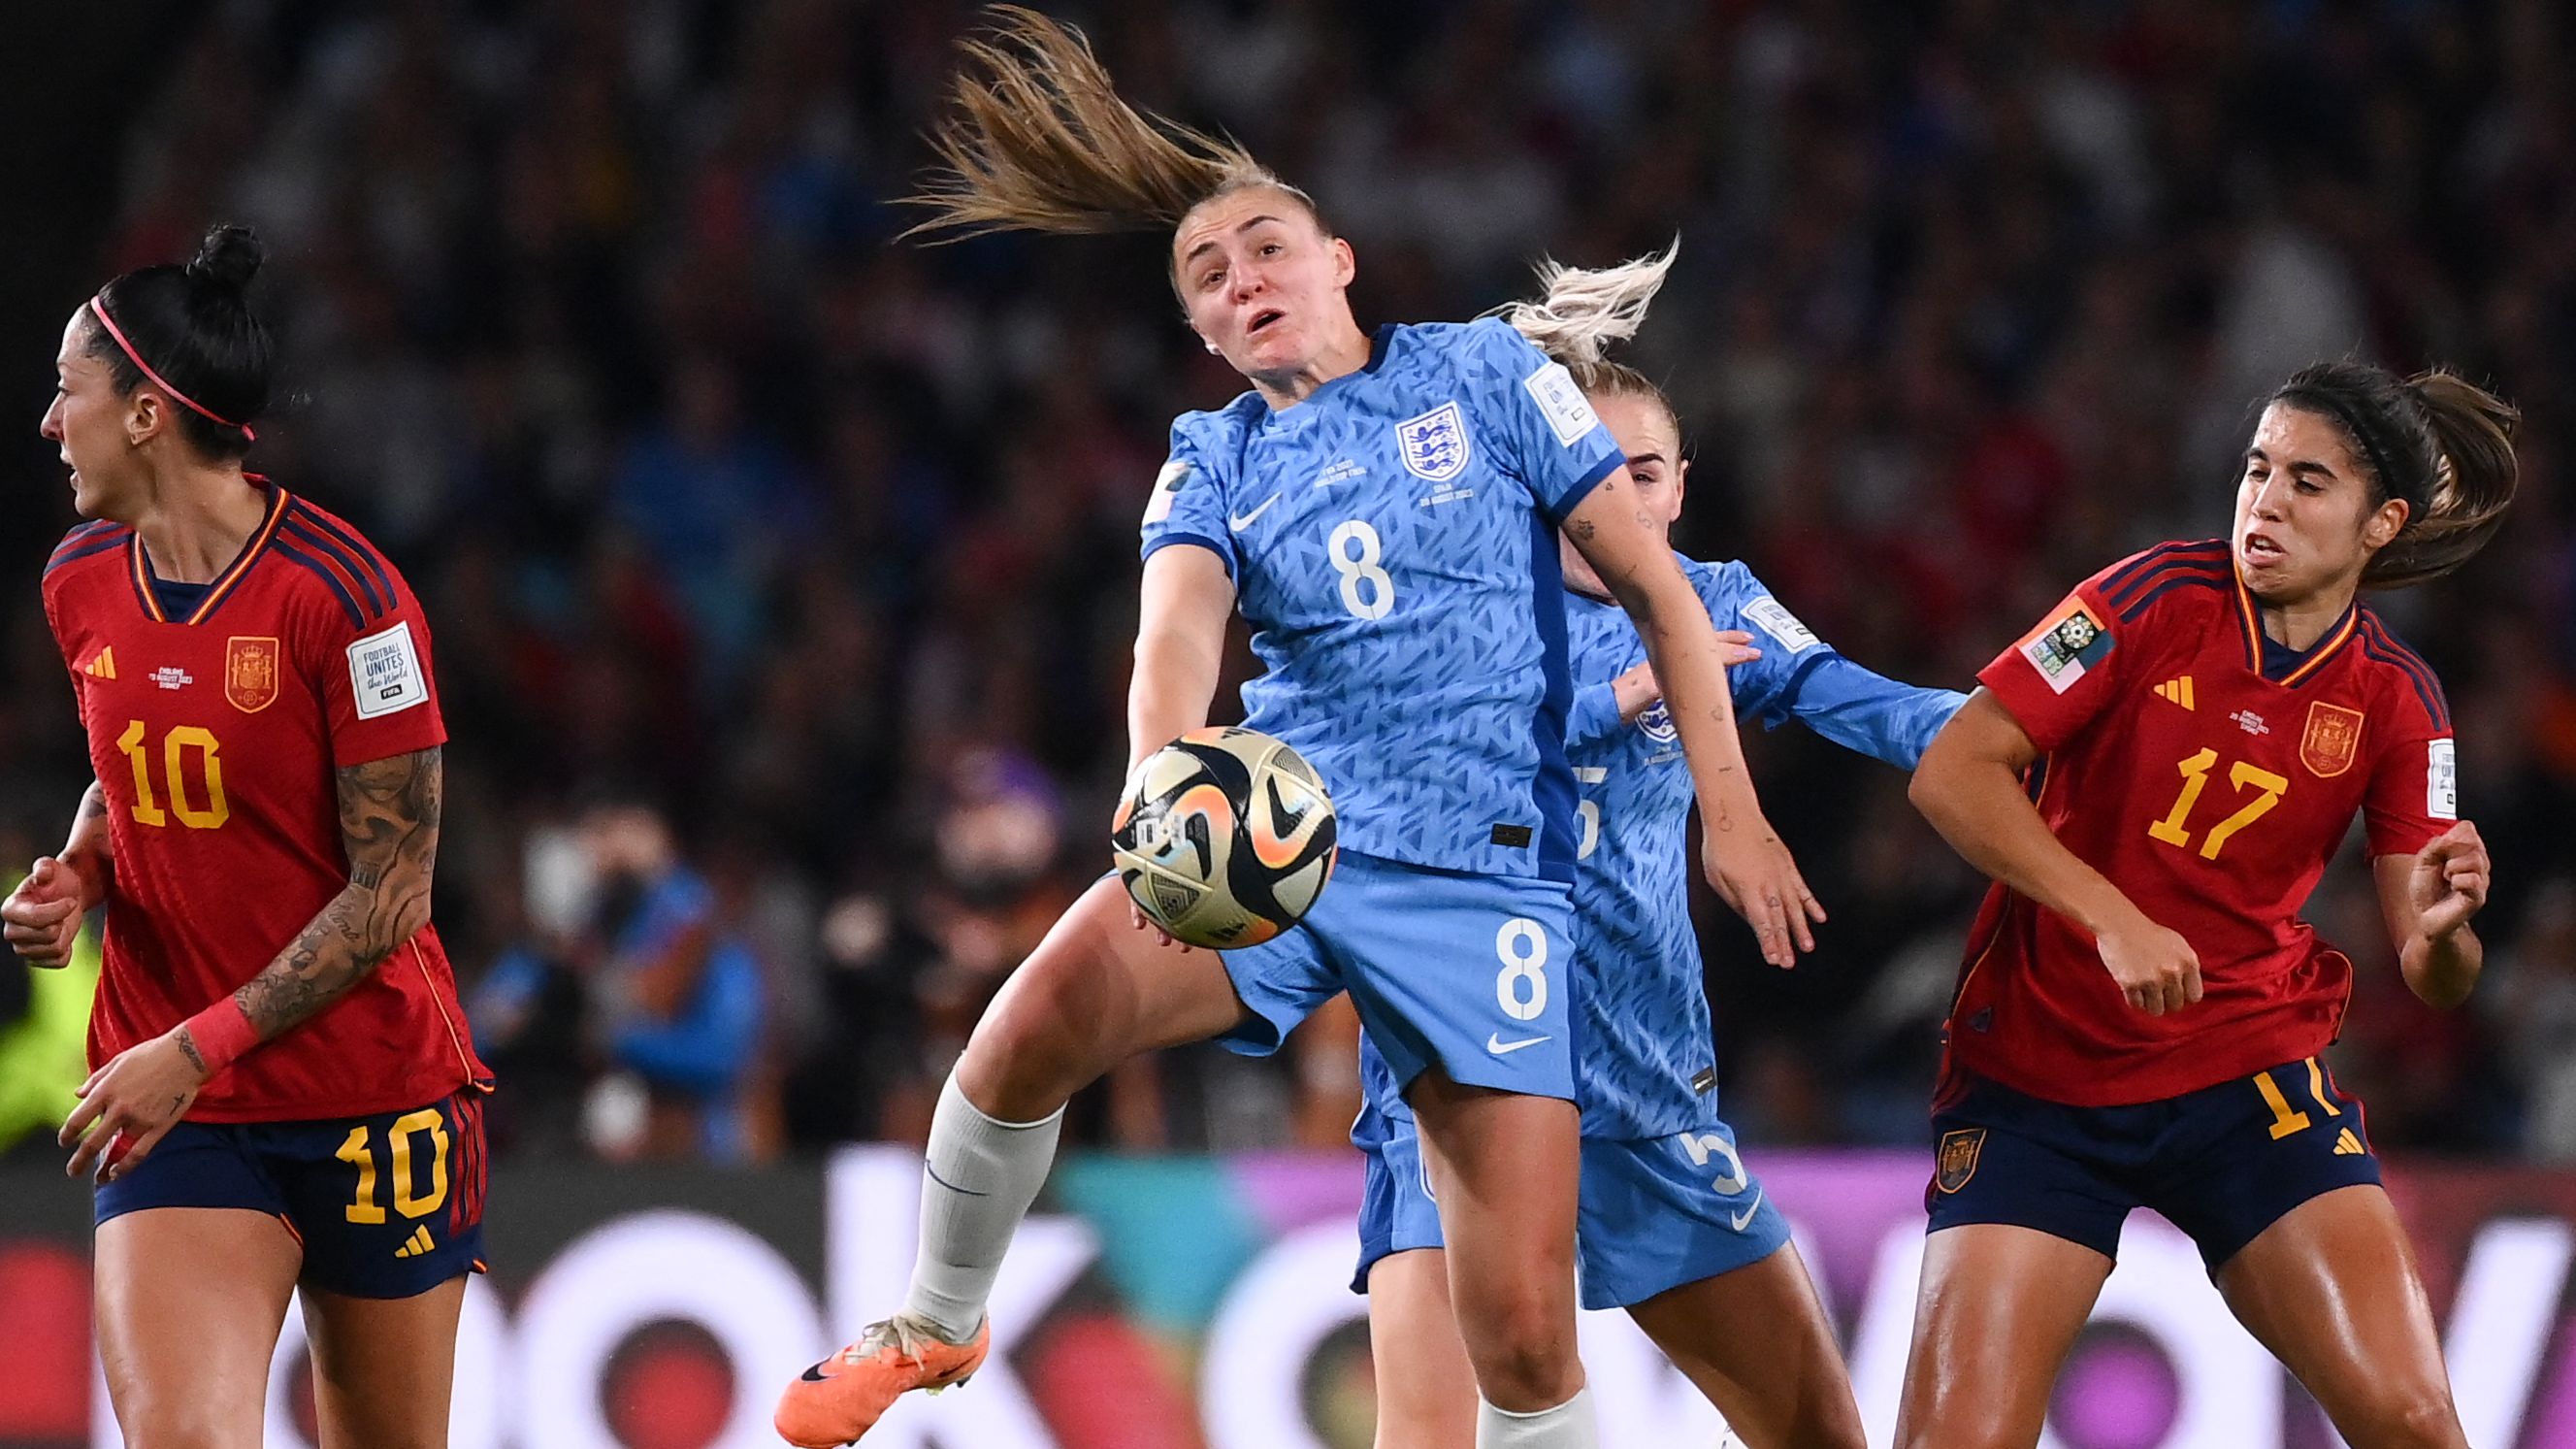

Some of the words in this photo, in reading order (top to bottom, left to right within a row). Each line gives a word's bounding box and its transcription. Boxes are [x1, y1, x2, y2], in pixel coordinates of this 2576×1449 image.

[1328, 520, 1395, 620] 8
[364, 642, 401, 664] FOOTBALL
[366, 652, 405, 677] UNITES
[116, 720, 229, 829] 10
[2148, 746, 2289, 861] 17
[1495, 917, 1549, 1021] 8
[335, 1108, 449, 1225] 10
[1679, 1132, 1747, 1197] 5
